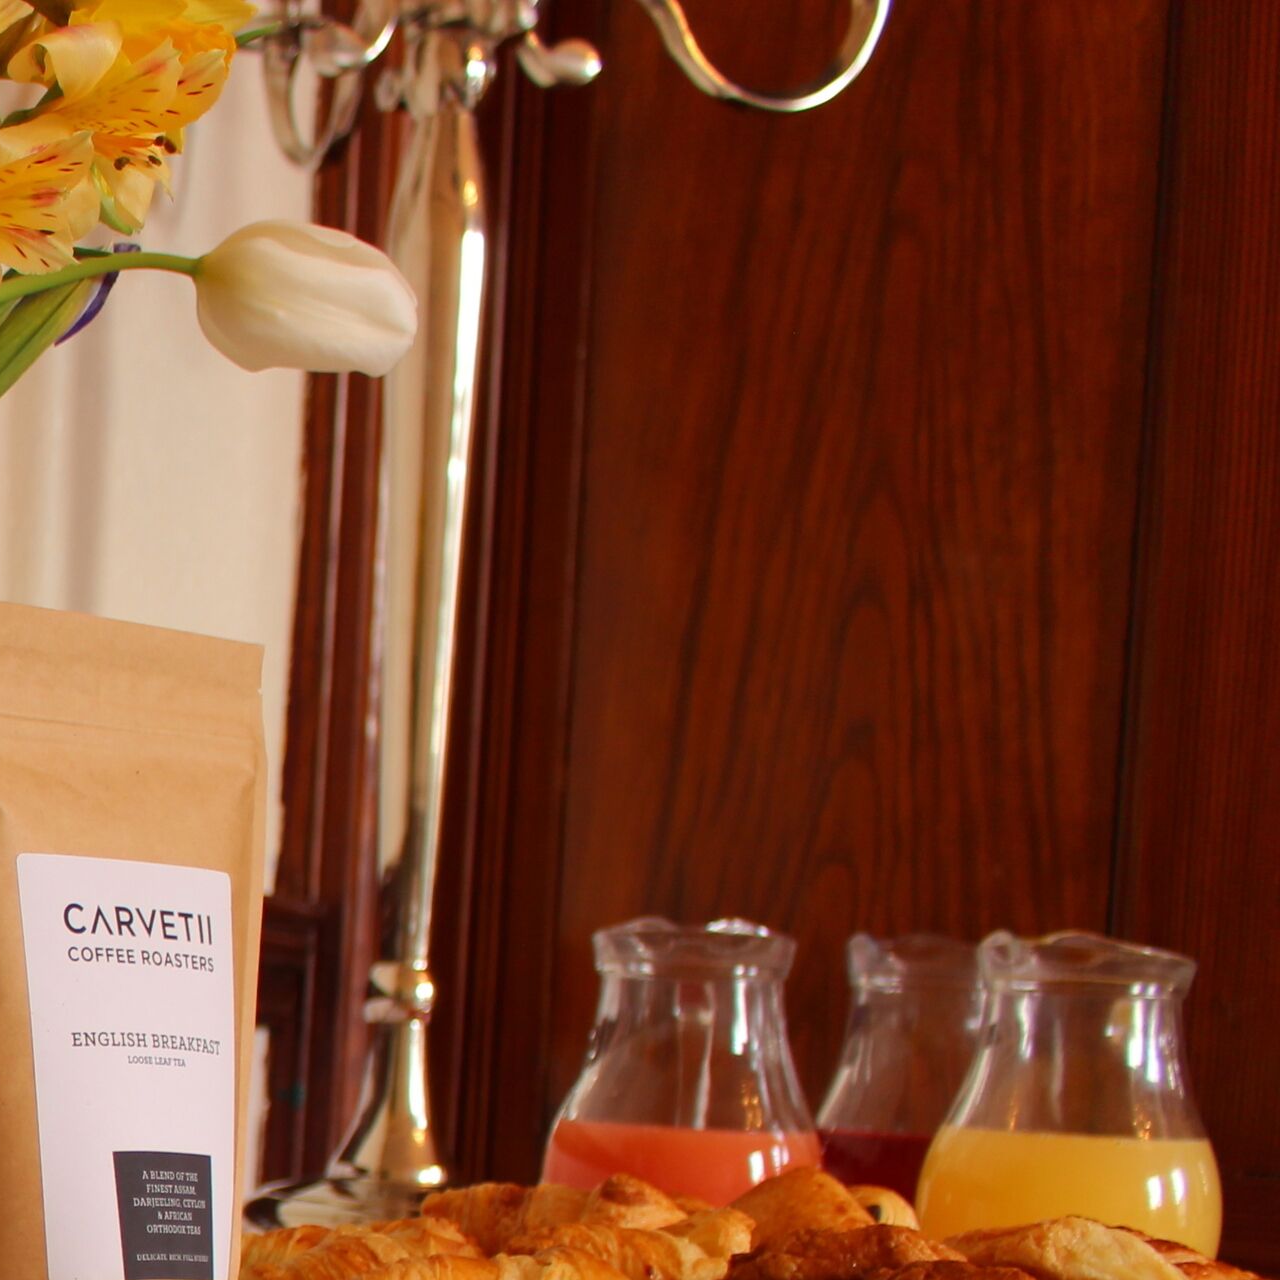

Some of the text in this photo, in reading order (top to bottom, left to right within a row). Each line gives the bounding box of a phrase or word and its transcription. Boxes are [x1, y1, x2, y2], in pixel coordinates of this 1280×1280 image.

[63, 903, 213, 946] CARVETII
[67, 946, 215, 973] COFFEE ROASTERS
[71, 1031, 221, 1056] ENGLISH BREAKFAST
[128, 1055, 187, 1068] LOOSE LEAF TEA
[142, 1170, 199, 1182] A BLEND OF THE
[146, 1184, 174, 1194] FINEST
[164, 1211, 193, 1221] AFRICAN
[146, 1224, 201, 1235] ORTHODOX TEAS
